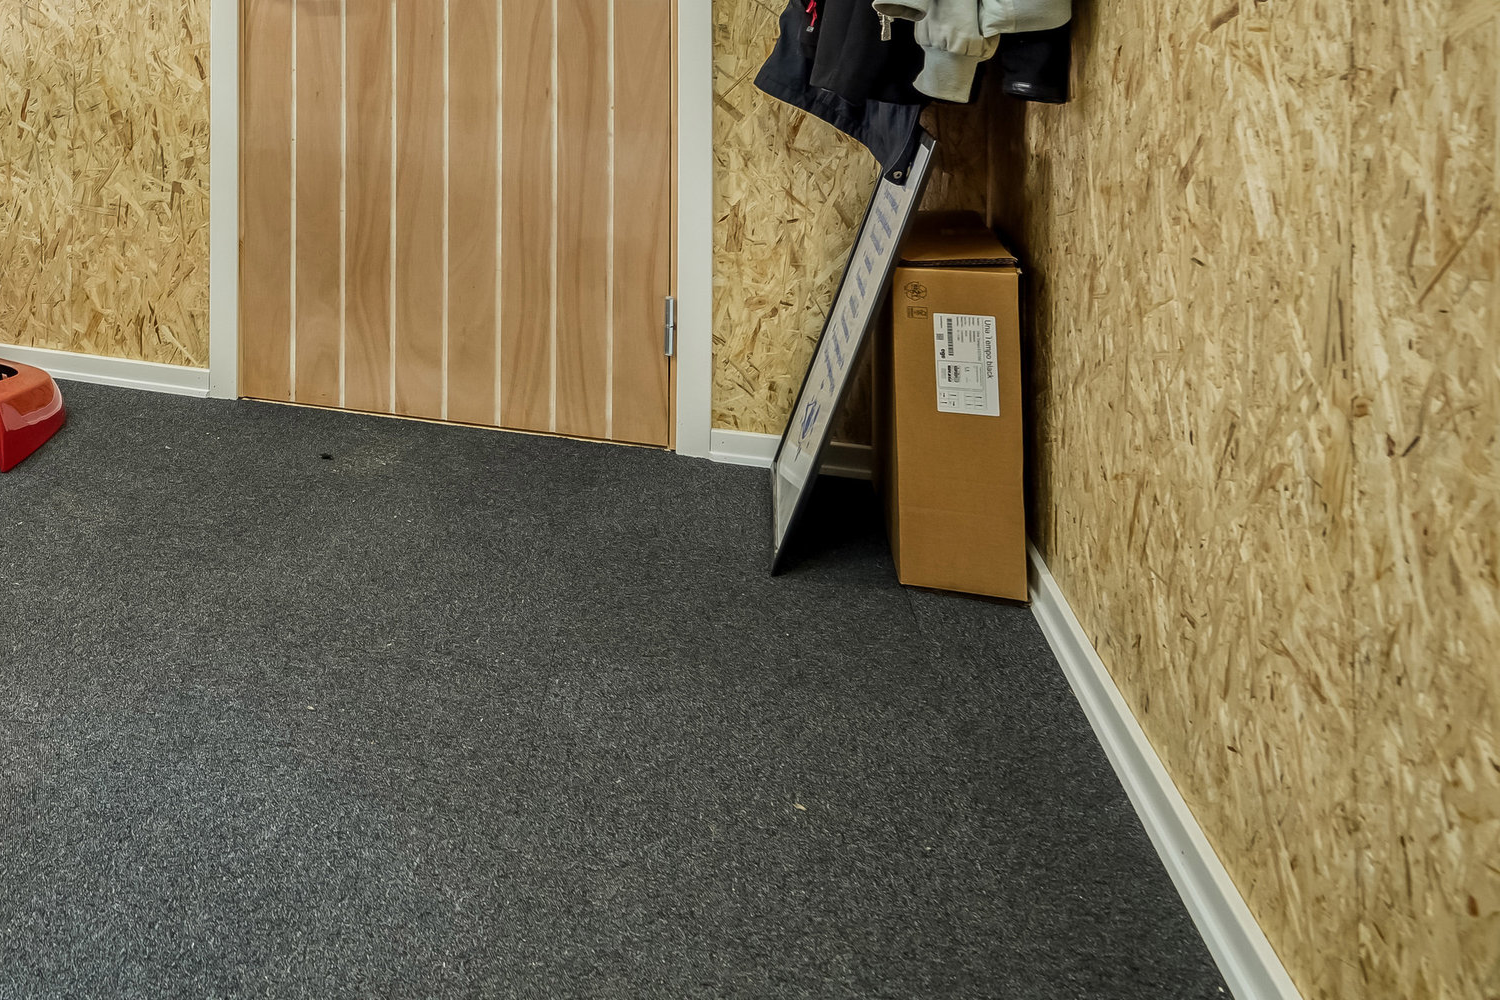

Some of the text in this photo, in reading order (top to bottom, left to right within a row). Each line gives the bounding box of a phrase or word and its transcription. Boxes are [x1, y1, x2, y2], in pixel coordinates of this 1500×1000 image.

[984, 319, 994, 379] Una Tempo black
